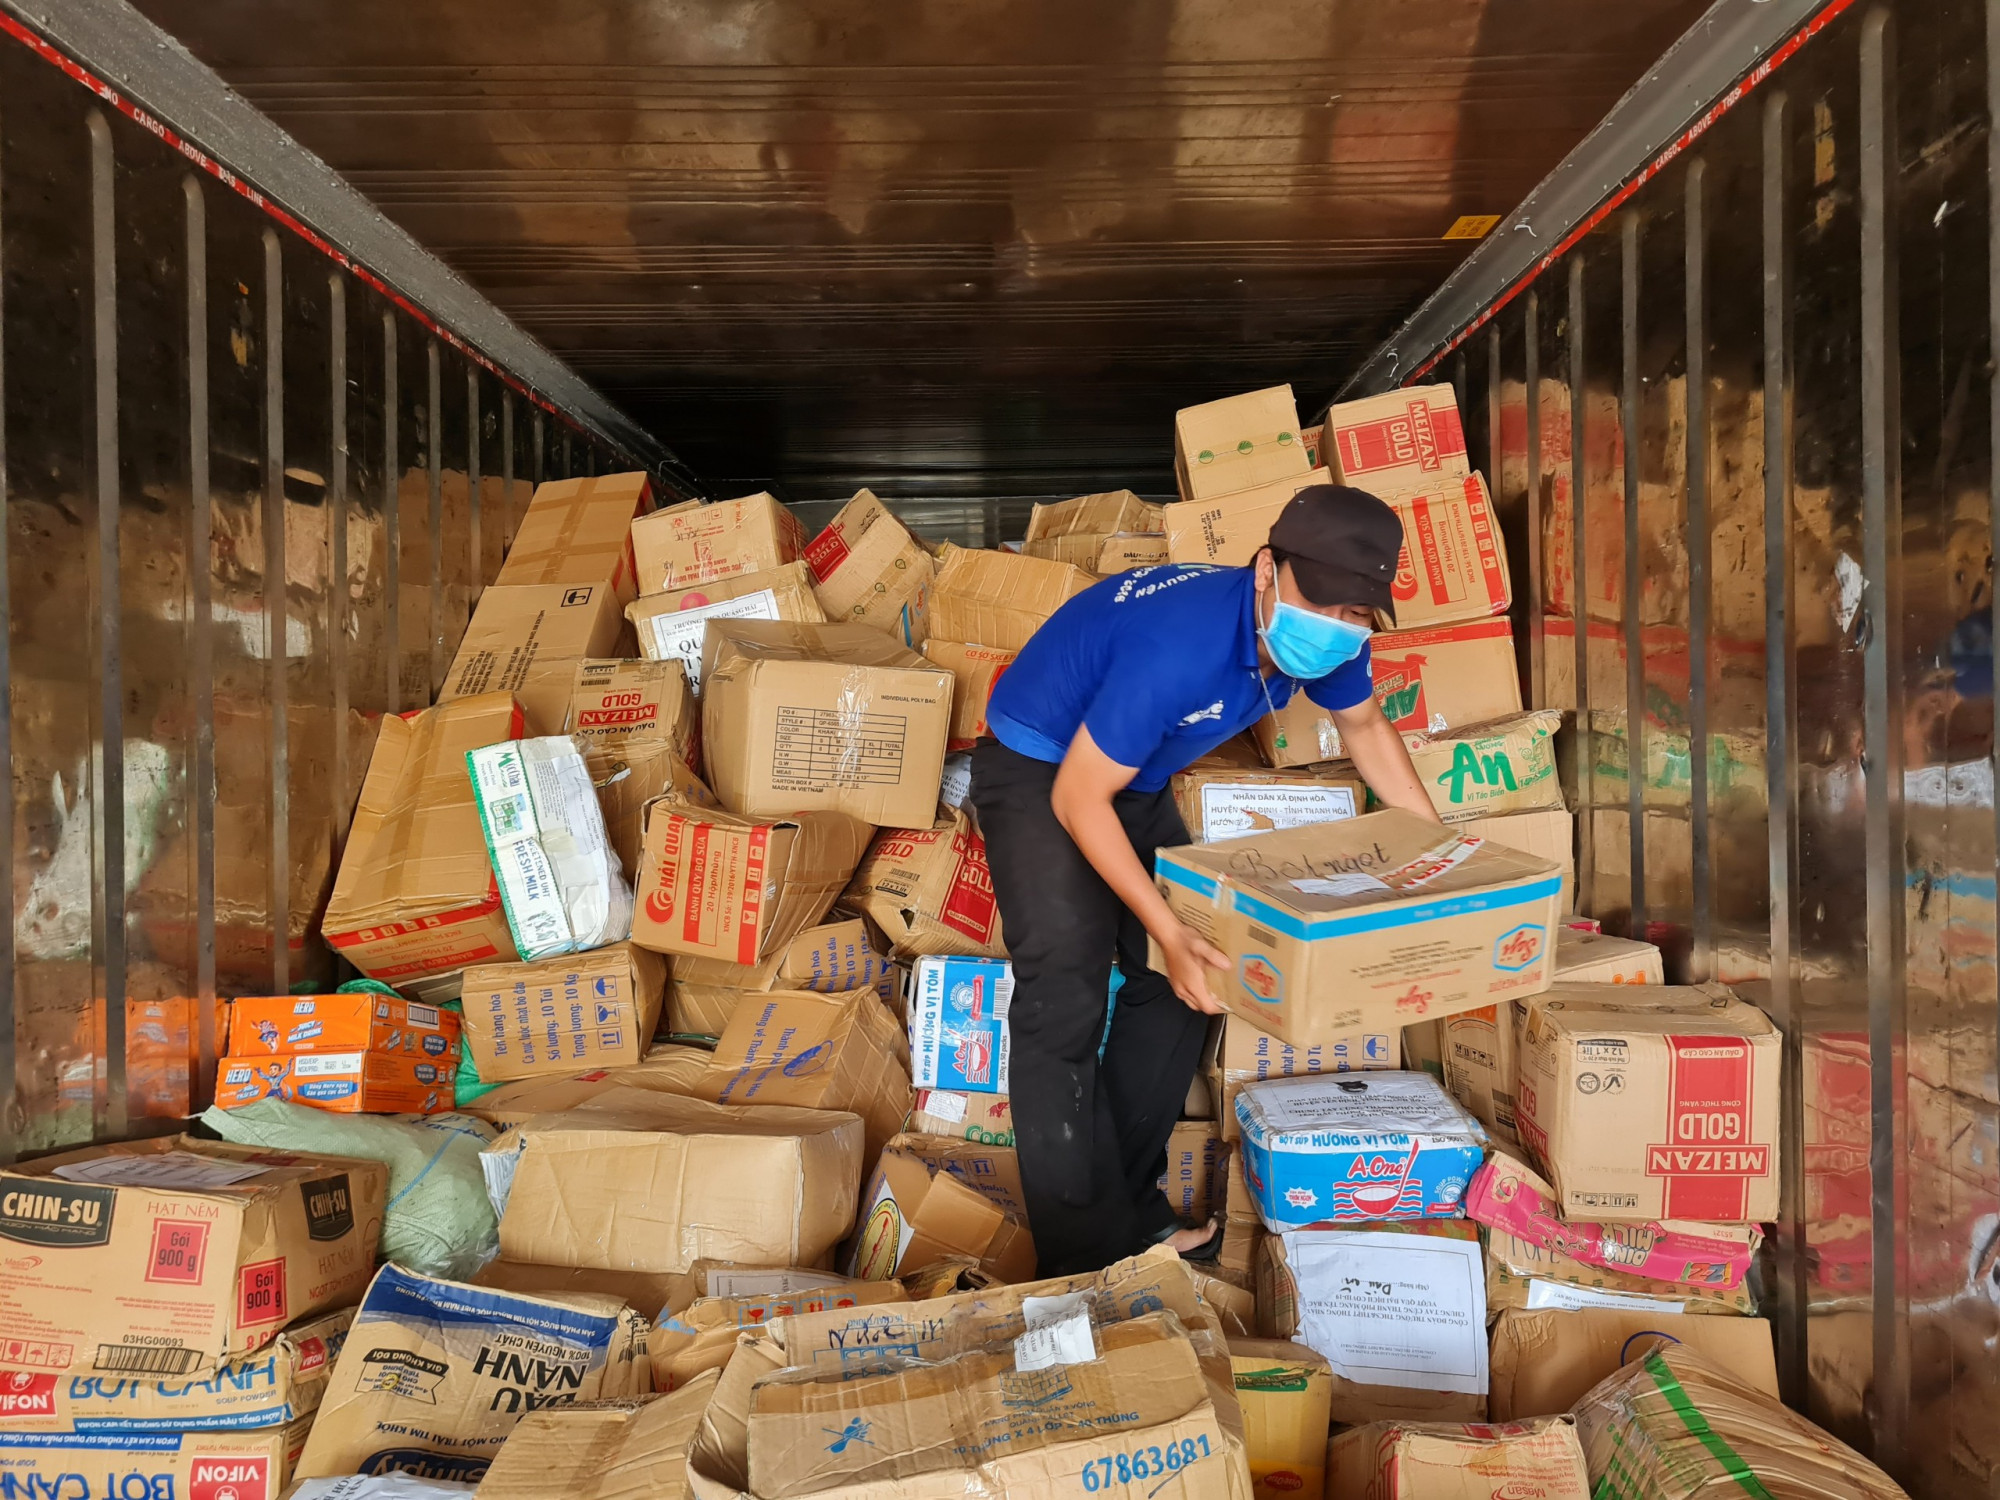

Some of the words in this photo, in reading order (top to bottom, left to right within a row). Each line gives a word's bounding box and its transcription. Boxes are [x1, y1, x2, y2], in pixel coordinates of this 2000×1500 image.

[1655, 143, 1680, 171] CARGO
[1688, 113, 1714, 142] ABOVE
[1750, 60, 1773, 86] LINE
[1390, 421, 1414, 460] GOLD
[1410, 402, 1437, 471] MEIZAN
[809, 540, 842, 566] GOLD
[1446, 563, 1456, 574] 20
[602, 693, 641, 708] GOLD
[581, 704, 657, 725] MEIZAN
[1437, 740, 1518, 803] An
[1232, 793, 1254, 802] NHÂN
[1257, 793, 1275, 802] DÂN
[1288, 794, 1306, 804] ĐỊNH
[1211, 805, 1238, 816] HUYỆN
[1283, 804, 1302, 815] TỈNH
[1304, 806, 1330, 816] THANH
[875, 842, 914, 859] GOLD
[512, 839, 533, 874] FRESH
[523, 875, 541, 901] MILK
[656, 860, 678, 890] HẢI
[708, 850, 722, 897] Hộp/thùng
[961, 865, 994, 895] GOLD
[539, 881, 551, 898] UHT
[689, 896, 699, 922] BÁNH
[706, 900, 714, 913] 20
[564, 973, 580, 986] Kg
[488, 994, 503, 1011] hóa
[539, 988, 554, 1004] Túi
[566, 988, 580, 1000] 10
[542, 1005, 556, 1018] 10
[491, 1013, 509, 1038] hàng
[571, 1034, 589, 1059] Trọng
[1612, 1047, 1624, 1057] 12
[1700, 1049, 1713, 1057] CAO
[1308, 1058, 1322, 1072] 10
[1679, 1099, 1699, 1108] VÀNG
[1700, 1099, 1719, 1108] THỨC
[1719, 1099, 1742, 1108] CÔNG
[1678, 1112, 1742, 1141] GOLD
[1312, 1130, 1360, 1147] HƯƠNG
[1365, 1134, 1379, 1149] VỊ
[1181, 1152, 1193, 1165] Túi
[1347, 1154, 1405, 1178] A-One
[1651, 1150, 1765, 1172] MEIZAN
[1181, 1169, 1192, 1181] 10
[2, 1191, 102, 1225] CHIN-SU
[146, 1201, 178, 1218] HẠT
[186, 1199, 220, 1218] NÊM
[310, 1189, 348, 1219] CHIN-SU
[170, 1231, 191, 1248] Gói
[158, 1249, 184, 1268] 900
[187, 1254, 197, 1273] g
[255, 1272, 274, 1288] Gói
[246, 1292, 270, 1310] 900
[273, 1290, 282, 1309] g
[1335, 1292, 1366, 1304] COVID-19
[1340, 1302, 1360, 1311] MANG
[1400, 1298, 1415, 1307] QUA
[1353, 1309, 1394, 1323] THCS&THPT
[1440, 1308, 1465, 1318] CHUNG
[122, 1333, 184, 1349] 03HG00093
[494, 1332, 524, 1351] CHẤT
[524, 1338, 567, 1360] NGUYÊN
[392, 1351, 426, 1368] KHÔNG
[568, 1347, 591, 1364] 100%
[240, 1389, 277, 1403] POWDER
[1094, 1410, 1140, 1427] THÙNG
[139, 1436, 156, 1445] CAM
[157, 1436, 178, 1445] VIFON
[1081, 1433, 1212, 1493] 67863681
[197, 1465, 259, 1482] VIFON
[100, 1467, 175, 1500] BỘT
[1507, 1485, 1546, 1499] Masan
